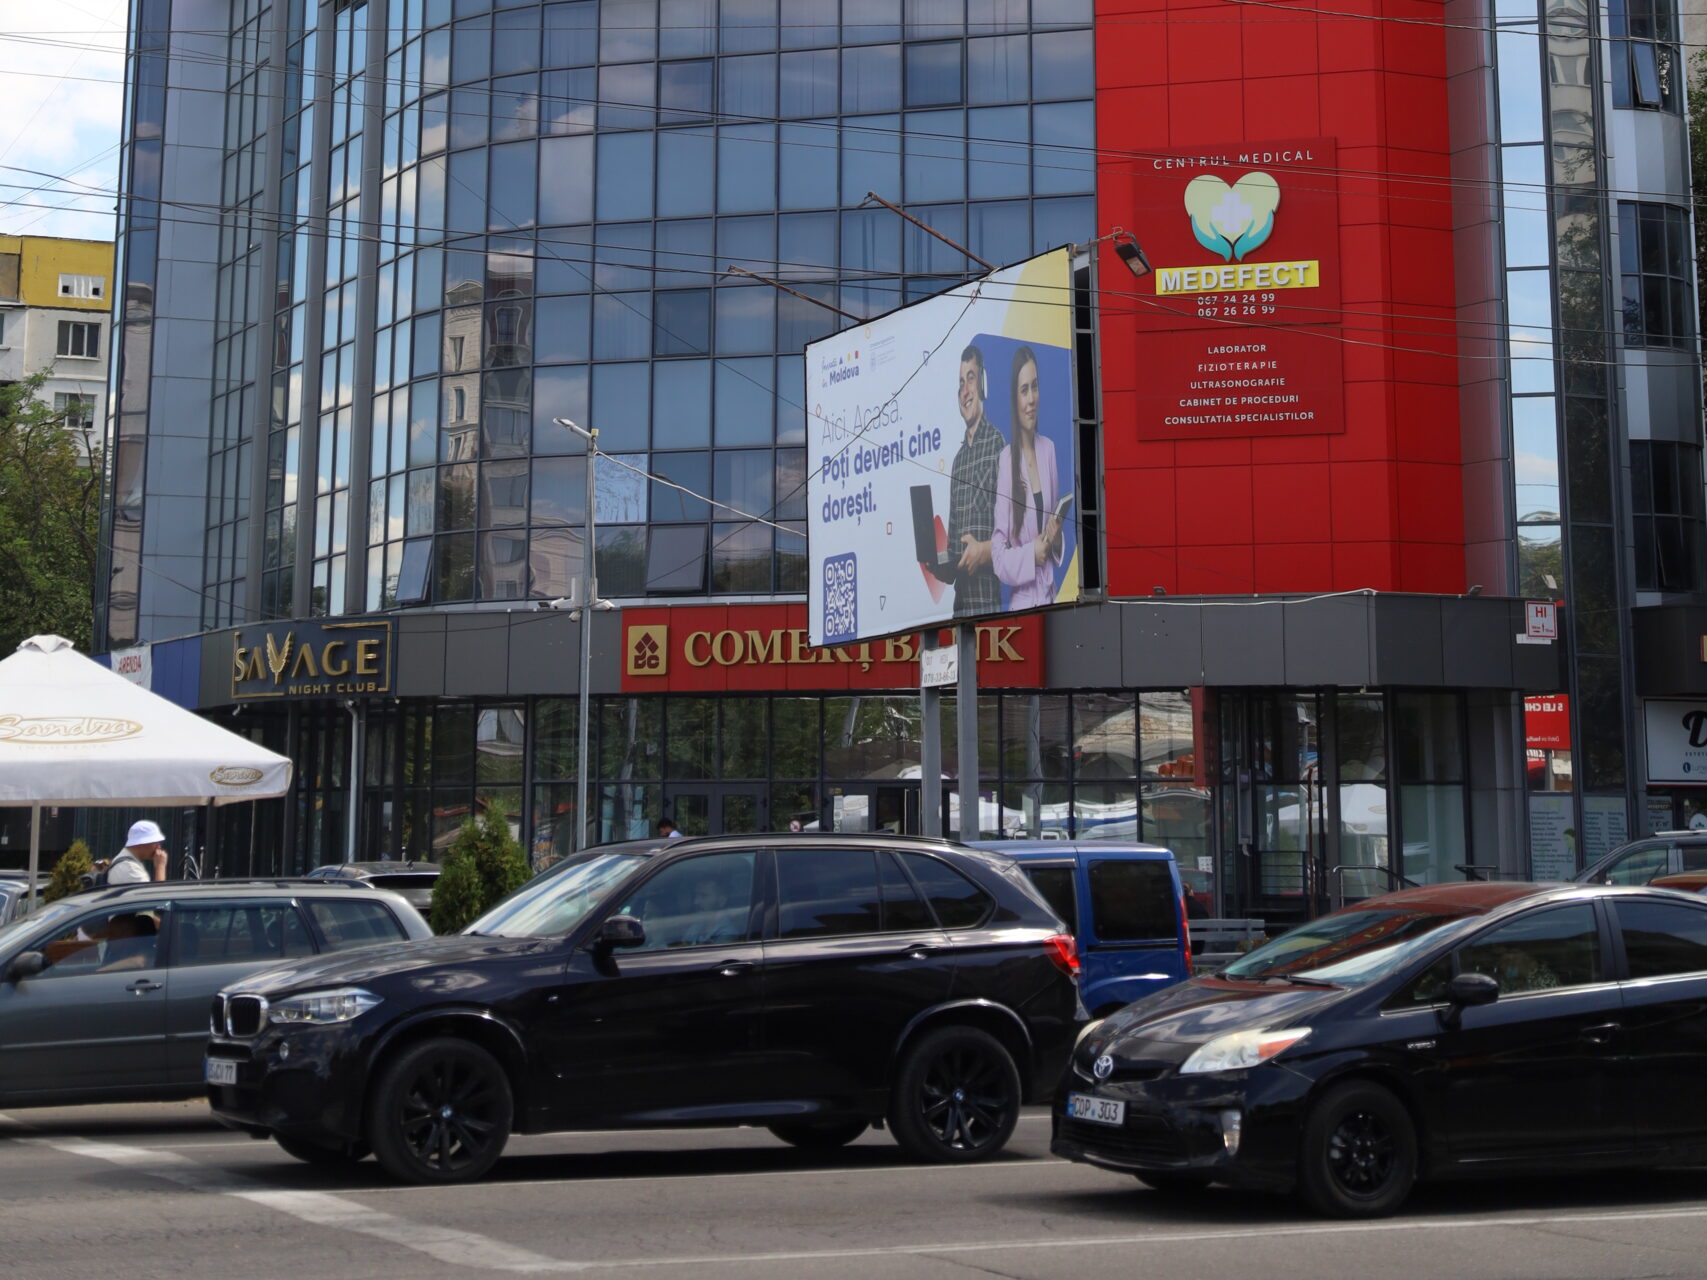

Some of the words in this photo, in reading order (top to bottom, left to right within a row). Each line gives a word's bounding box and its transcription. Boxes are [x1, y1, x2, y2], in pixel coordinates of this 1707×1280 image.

[1153, 155, 1230, 170] CENTRUL
[1239, 150, 1314, 164] MEDICAL
[1161, 263, 1309, 293] MEDEFECT
[1197, 296, 1217, 306] 067
[1223, 295, 1237, 305] 24
[1242, 294, 1256, 304] 24
[1261, 293, 1275, 303] 99
[1197, 307, 1217, 317] 067
[1223, 306, 1237, 316] 26
[1242, 305, 1256, 315] 26
[1261, 304, 1275, 314] 99
[1207, 344, 1266, 355] LABORATOR
[1198, 360, 1278, 372] FIZIOTERAPIE
[829, 365, 860, 386] Moldova
[1190, 377, 1286, 390] ULTRASONOGRAFIE
[1179, 397, 1221, 408] CABINET
[1224, 396, 1238, 406] DE
[1241, 394, 1299, 406] PROCEDURI
[1164, 415, 1232, 426] CONSULTATIA
[1234, 411, 1315, 423] SPECIALISTILOR
[821, 447, 850, 490] Poți
[853, 429, 904, 476] deveni
[908, 423, 942, 458] cine
[821, 481, 877, 526] dorești.
[234, 631, 380, 685] SAVAGE
[288, 684, 331, 695] NIGHT
[336, 682, 377, 693] CLUB
[1098, 1101, 1119, 1121] 303
